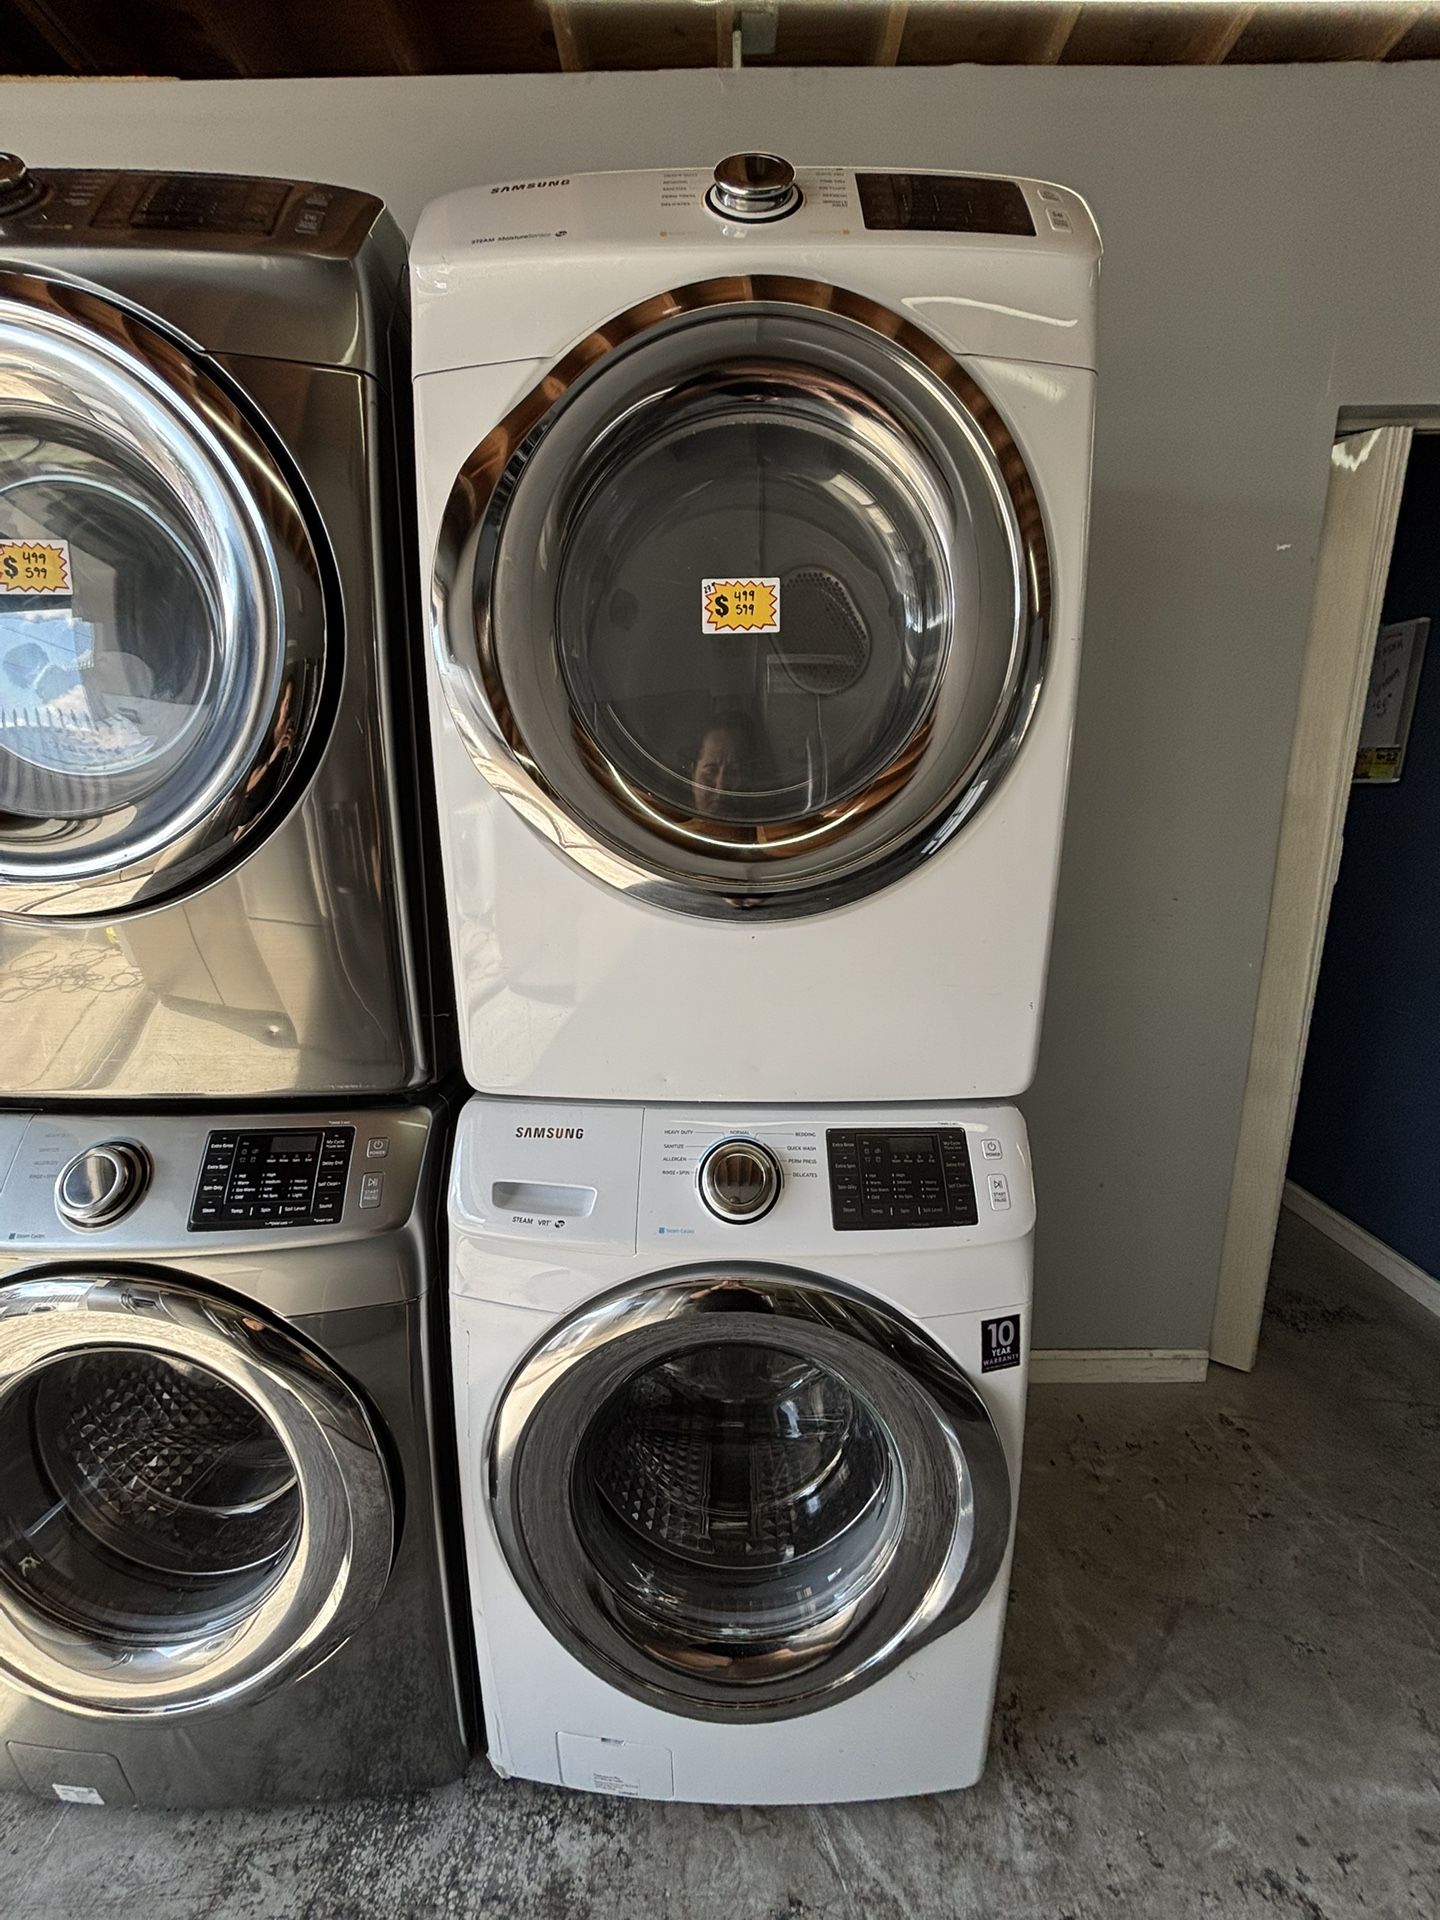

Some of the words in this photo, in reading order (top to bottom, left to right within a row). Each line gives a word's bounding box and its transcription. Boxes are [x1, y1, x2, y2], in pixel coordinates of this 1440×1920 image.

[490, 179, 571, 195] SAMSUNG
[471, 237, 495, 245] STEAM
[3, 555, 19, 579] $
[22, 551, 46, 564] 499
[25, 566, 48, 579] 599
[714, 594, 729, 618] $
[734, 590, 755, 602] 499
[735, 603, 755, 616] 599
[515, 1126, 585, 1140] SAMSUNG
[511, 1215, 534, 1225] STEAM
[987, 1320, 1015, 1348] 10
[991, 1347, 1011, 1357] YEAR
[983, 1354, 1019, 1366] WARRANTY
